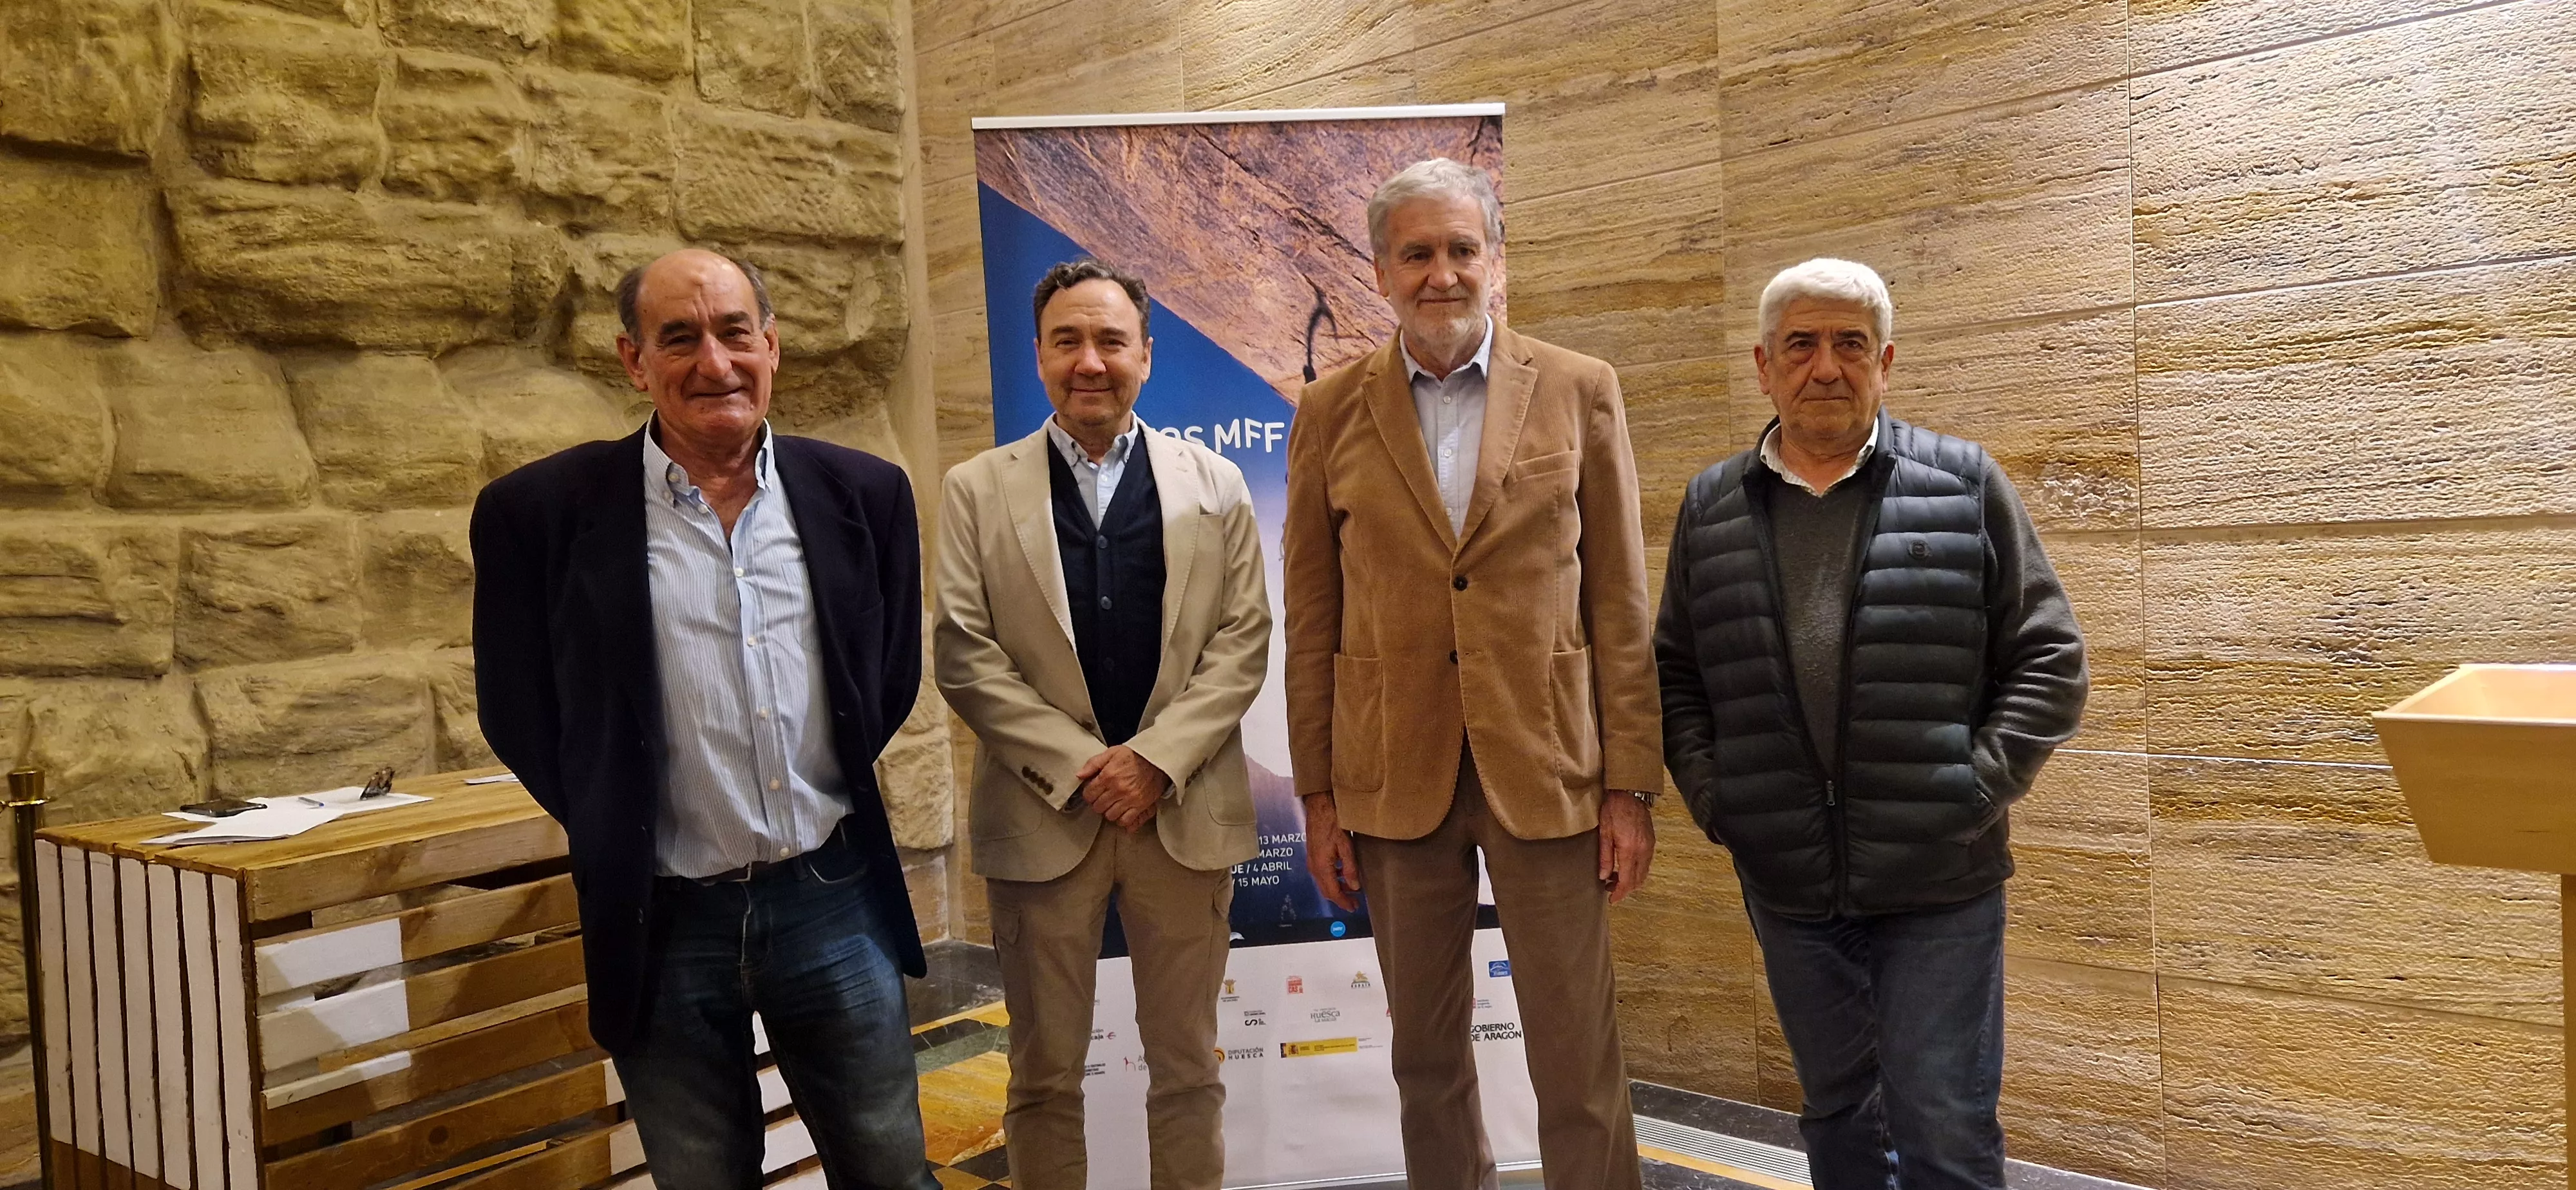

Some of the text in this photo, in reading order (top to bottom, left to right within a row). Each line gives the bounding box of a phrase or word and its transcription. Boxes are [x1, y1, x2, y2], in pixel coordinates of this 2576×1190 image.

[1215, 418, 1285, 454] MFF
[1258, 835, 1269, 845] 13
[1253, 864, 1259, 873] 4
[1261, 861, 1293, 872] ABRIL
[1238, 878, 1248, 887] 15
[1251, 875, 1280, 887] MAYO
[1484, 1031, 1522, 1041] ARAGON
[1228, 1046, 1264, 1055] DIPUTACIÓN
